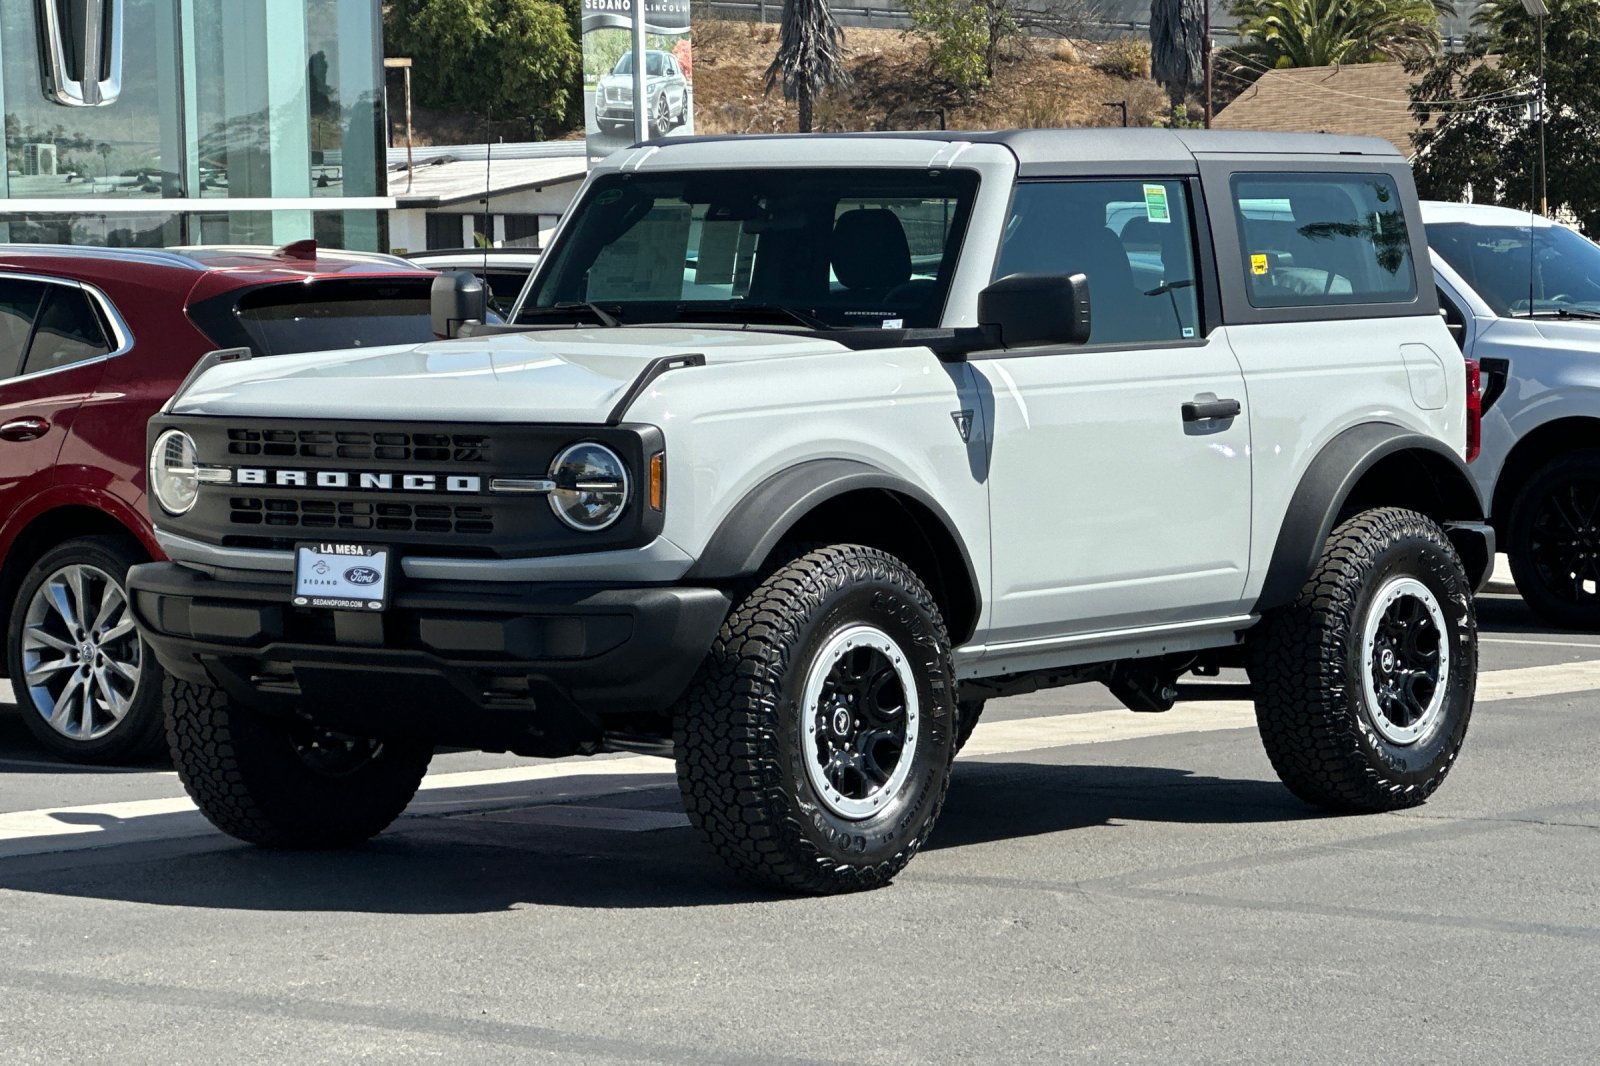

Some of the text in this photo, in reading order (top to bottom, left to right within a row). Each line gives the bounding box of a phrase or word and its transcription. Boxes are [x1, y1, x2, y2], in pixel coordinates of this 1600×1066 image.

[585, 0, 631, 10] SEDANO
[644, 4, 687, 12] LINCOLN
[237, 468, 481, 492] BRONCO
[321, 544, 363, 555] LA MESA
[350, 568, 375, 583] Ford
[303, 578, 338, 586] SEDANO
[313, 598, 363, 608] SEDANOFORD.COM
